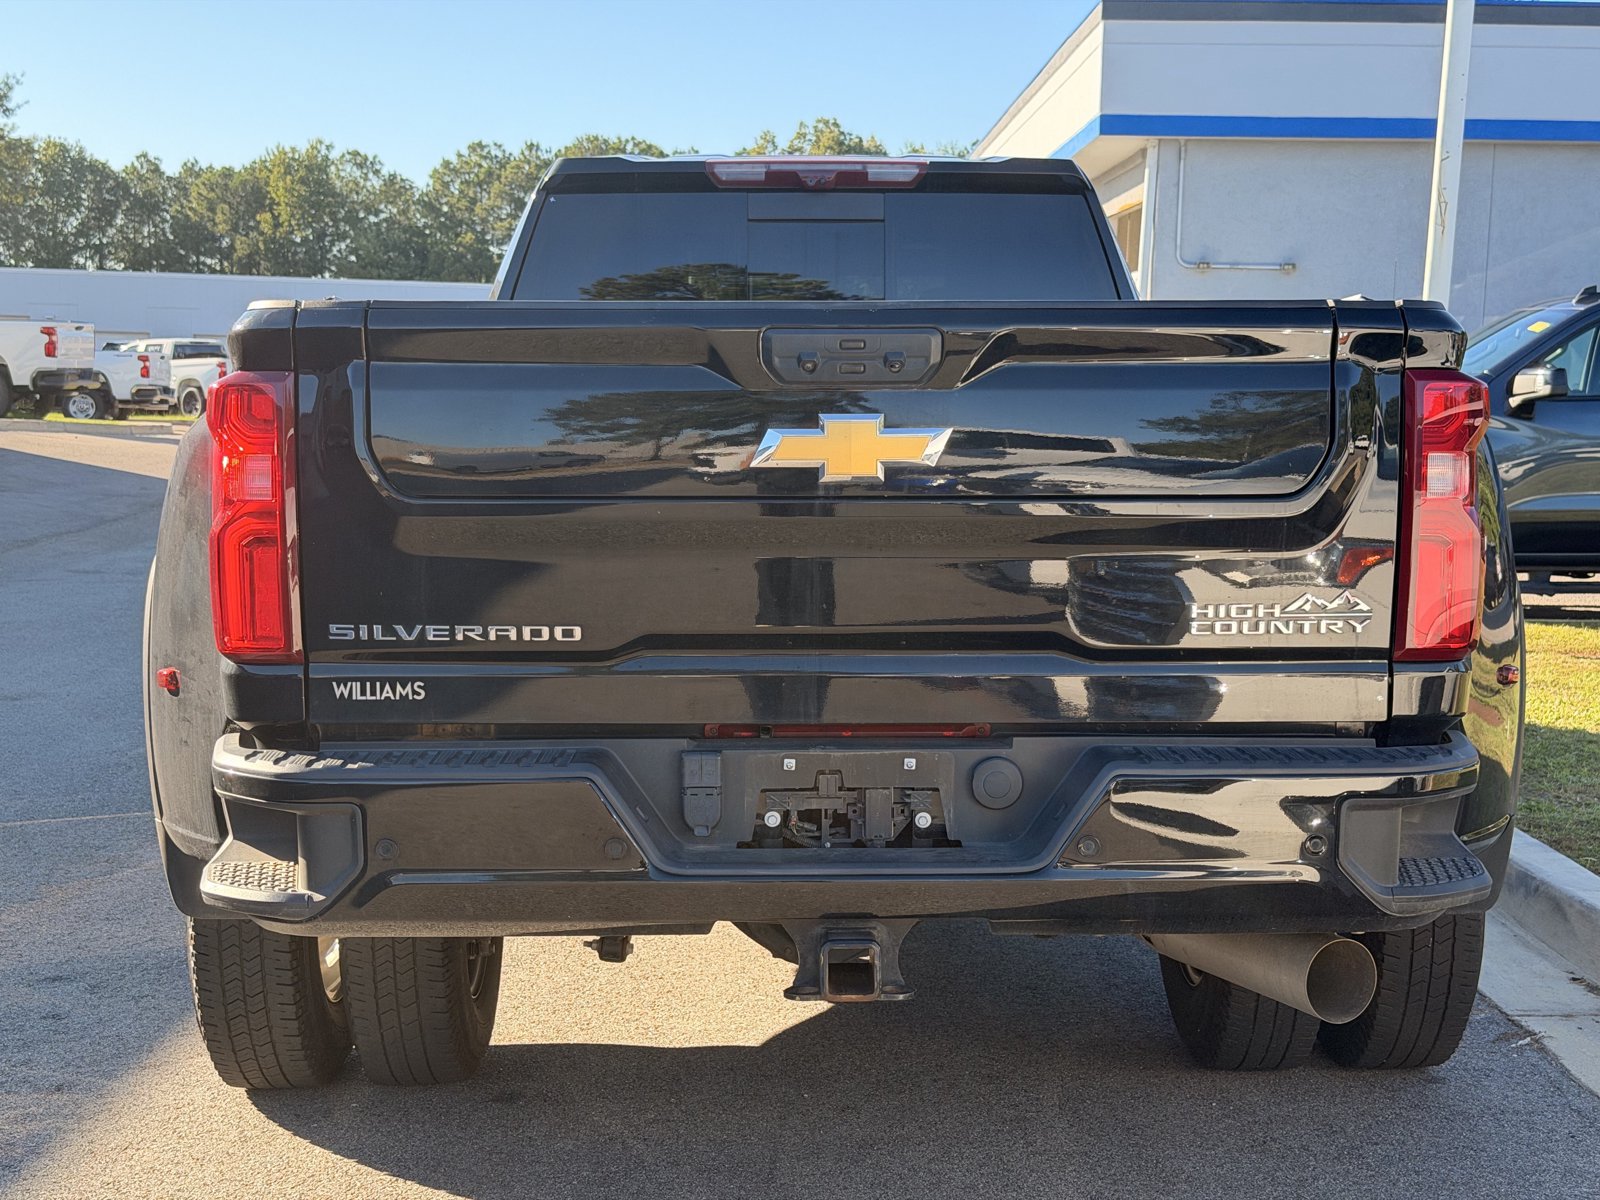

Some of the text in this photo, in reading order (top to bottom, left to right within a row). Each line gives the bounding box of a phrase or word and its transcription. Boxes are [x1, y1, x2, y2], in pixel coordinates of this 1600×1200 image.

[1190, 603, 1281, 618] HIGH
[328, 623, 583, 641] SILVERADO
[1189, 619, 1371, 635] COUNTRY
[332, 681, 426, 701] WILLIAMS
